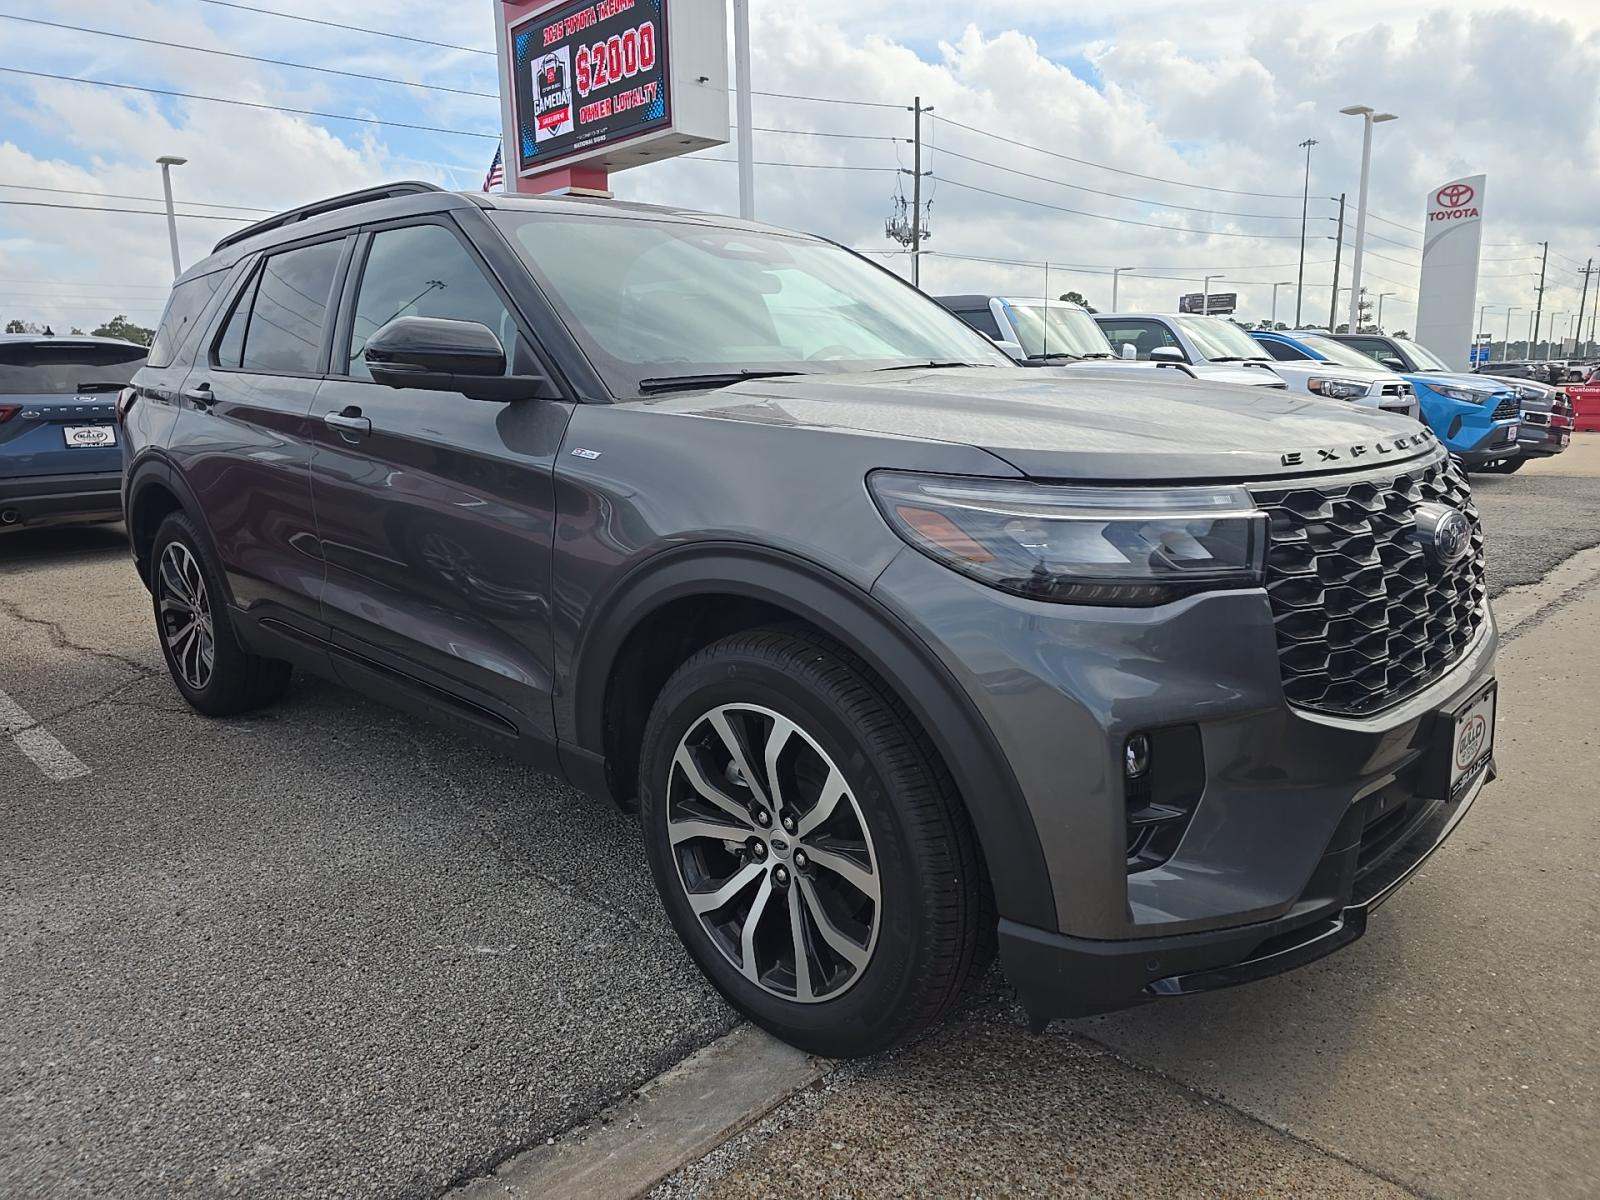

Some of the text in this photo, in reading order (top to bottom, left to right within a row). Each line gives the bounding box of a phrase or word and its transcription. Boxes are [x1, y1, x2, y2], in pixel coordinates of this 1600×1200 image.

[563, 6, 598, 36] TOYOTA
[574, 20, 656, 98] $2000
[533, 87, 572, 116] GAMEDAY
[579, 80, 658, 125] OWNER LOYALTY
[1429, 208, 1479, 222] TOYOTA
